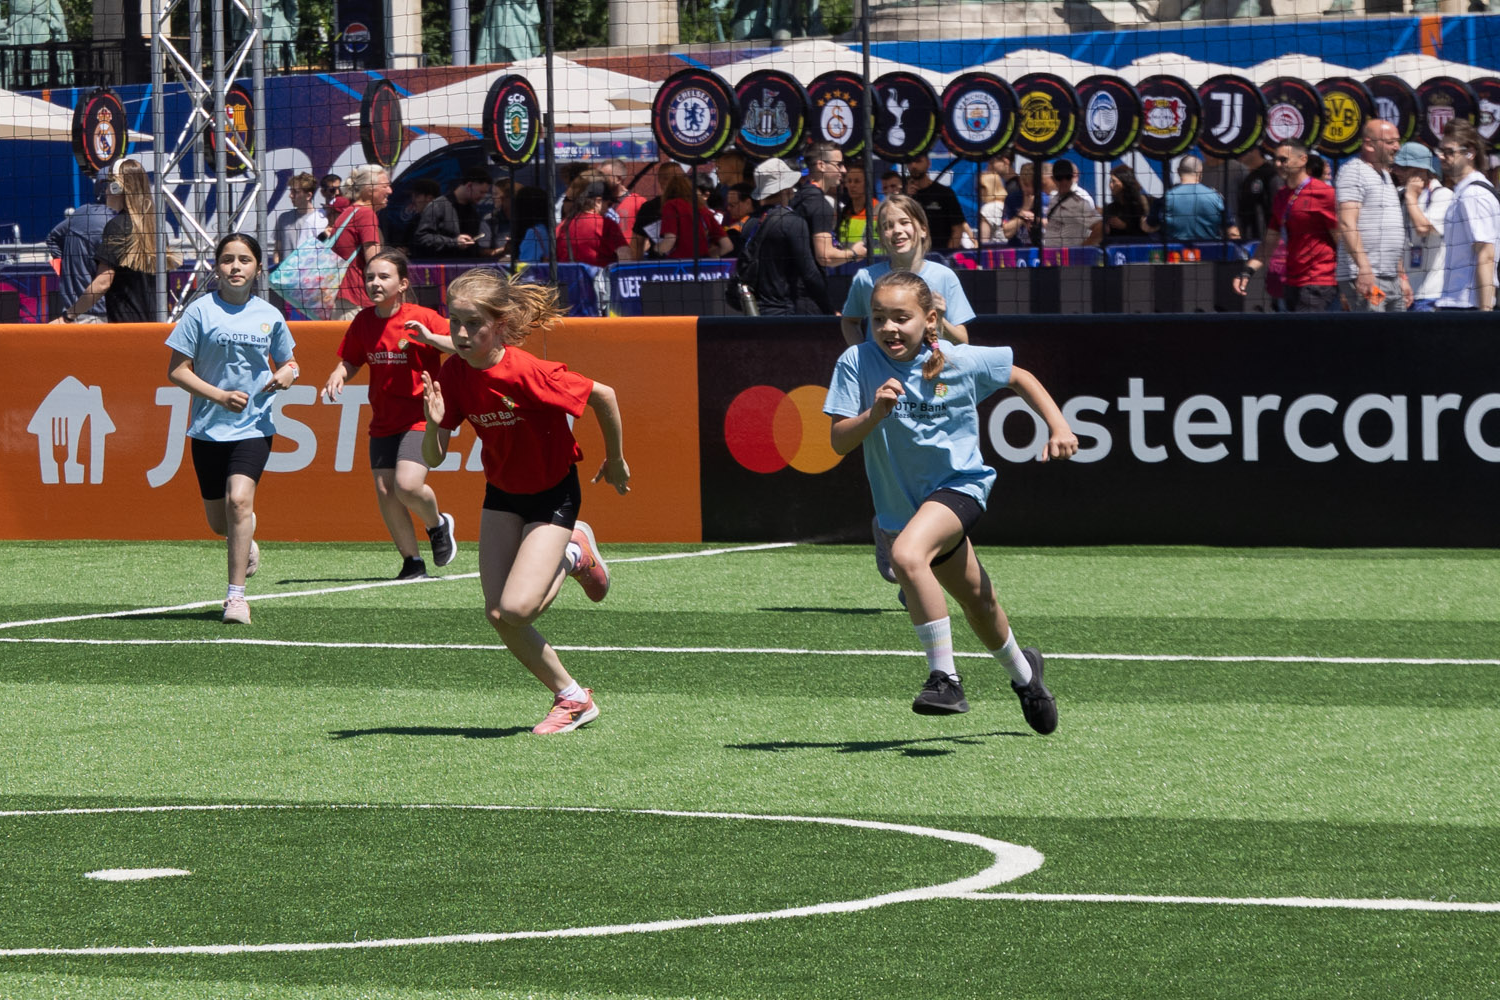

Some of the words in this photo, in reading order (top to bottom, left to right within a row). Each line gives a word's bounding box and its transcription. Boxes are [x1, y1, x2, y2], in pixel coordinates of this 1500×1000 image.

[507, 93, 526, 105] SCP
[676, 89, 710, 104] CHELSEA
[618, 275, 646, 298] UEF
[232, 333, 249, 342] OTP
[388, 352, 408, 360] Bank
[895, 401, 917, 411] OTP
[920, 402, 947, 412] Bank
[480, 412, 497, 423] OTP
[147, 384, 369, 488] JST
